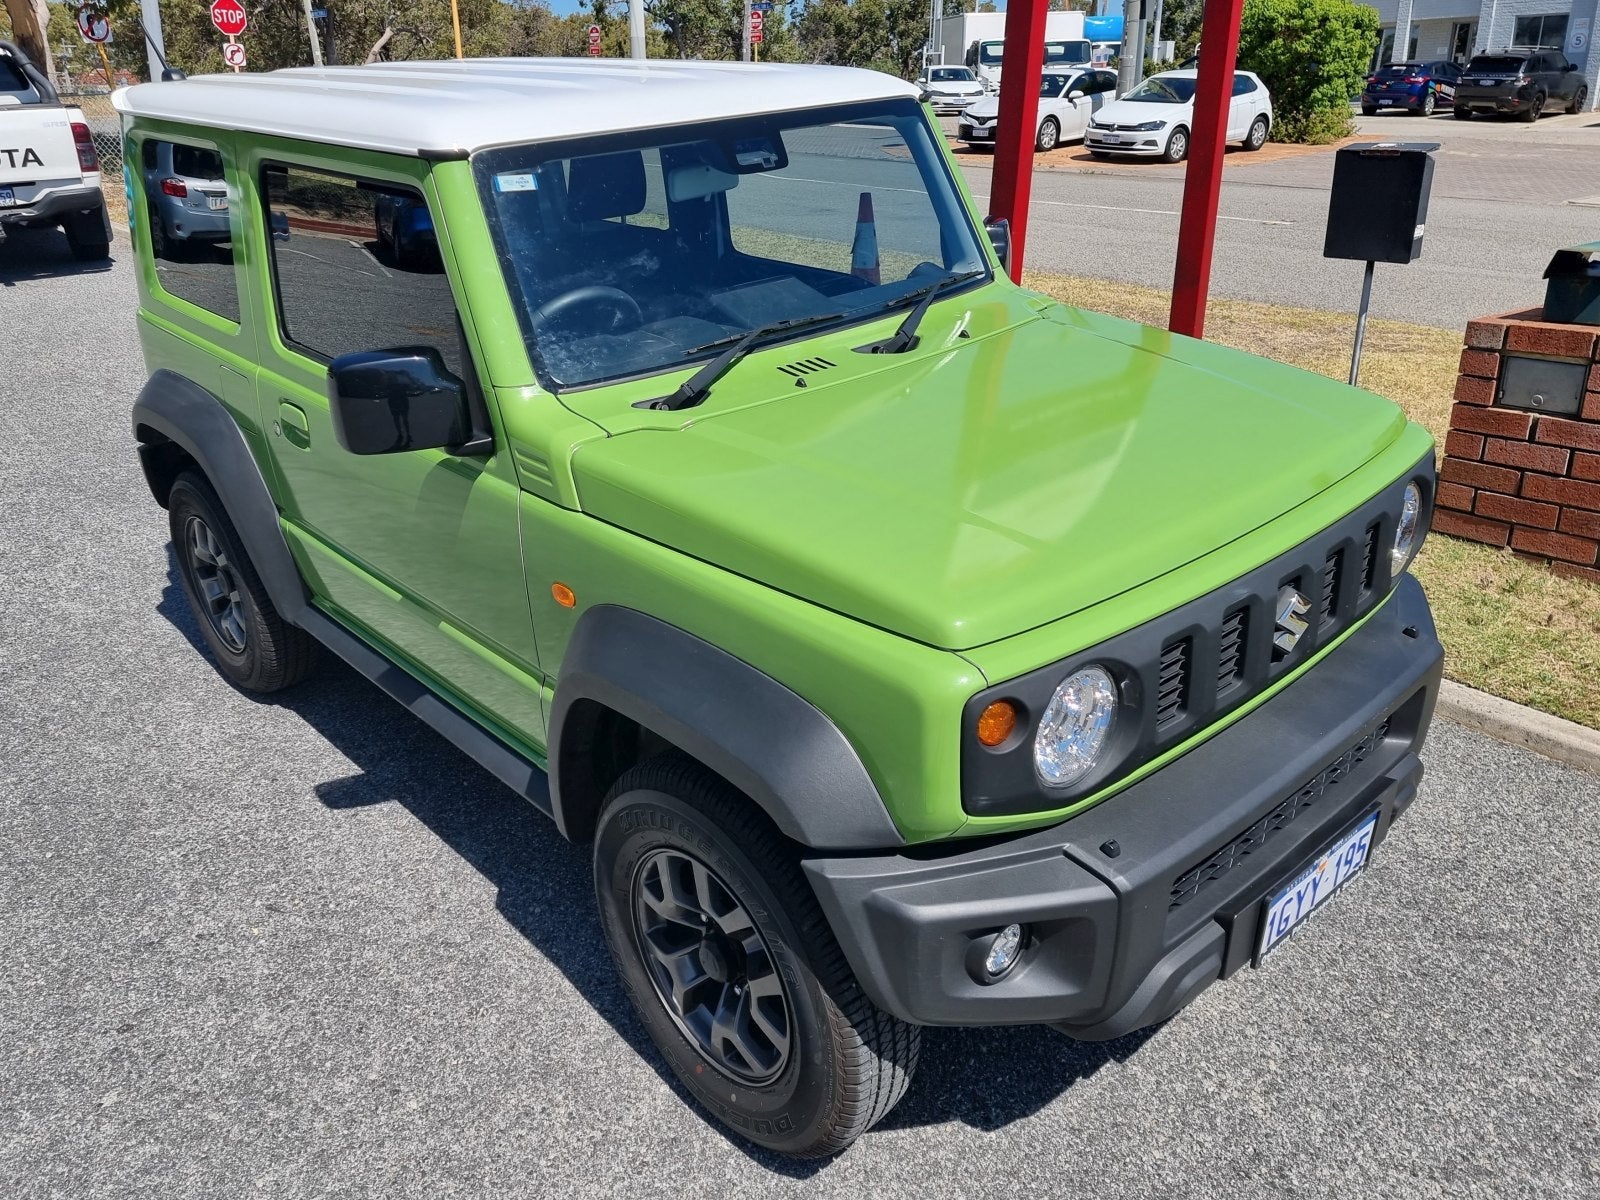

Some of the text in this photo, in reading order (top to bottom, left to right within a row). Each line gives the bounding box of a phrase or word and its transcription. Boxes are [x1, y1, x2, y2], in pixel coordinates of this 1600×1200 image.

[214, 8, 243, 24] STOP
[1574, 36, 1582, 45] 5
[0, 147, 45, 168] TA
[618, 808, 799, 991] BRIDGESTONE
